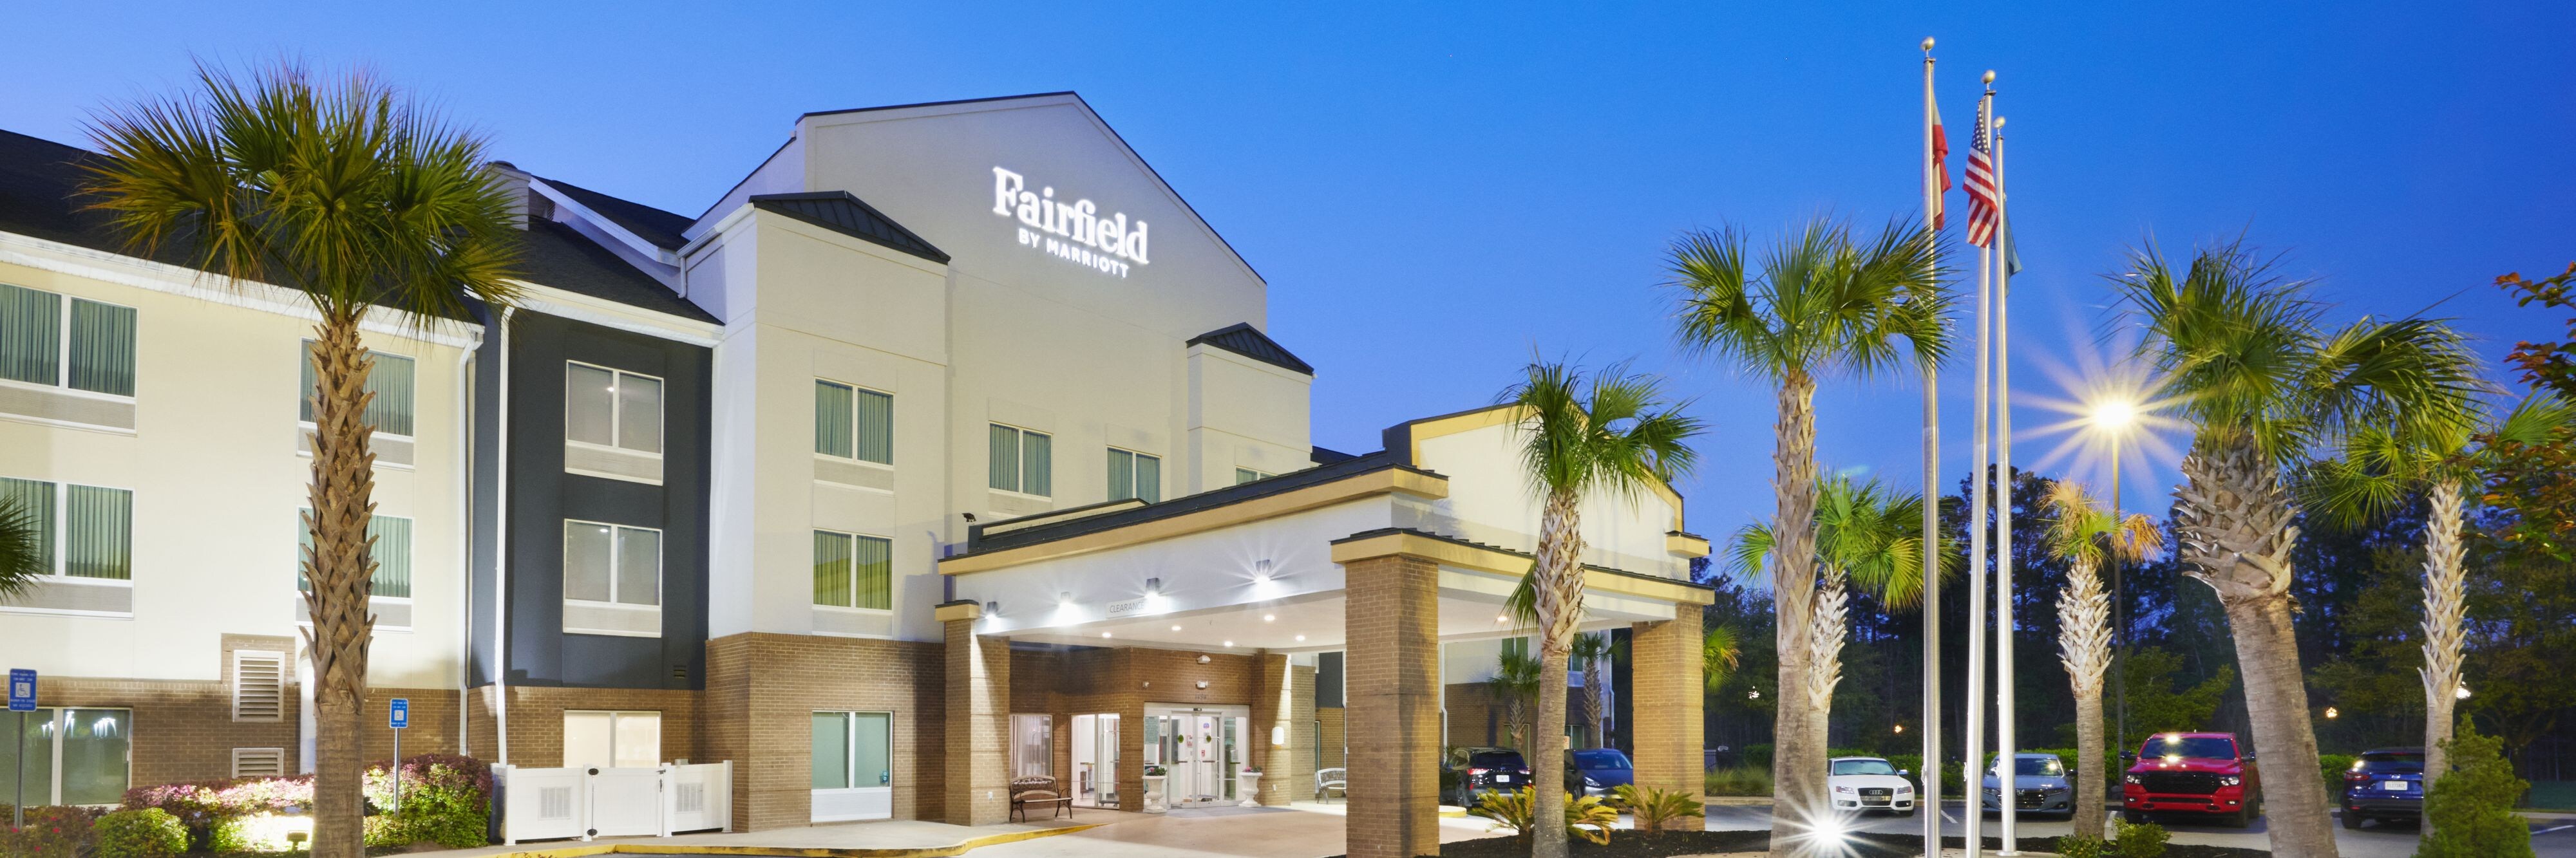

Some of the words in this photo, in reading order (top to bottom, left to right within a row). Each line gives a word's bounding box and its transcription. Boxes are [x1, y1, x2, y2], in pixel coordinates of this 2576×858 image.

[992, 166, 1150, 265] Fairfield
[1018, 228, 1040, 248] BY
[1046, 238, 1129, 278] MARRIOTT
[1110, 601, 1144, 613] CLEARANCE
